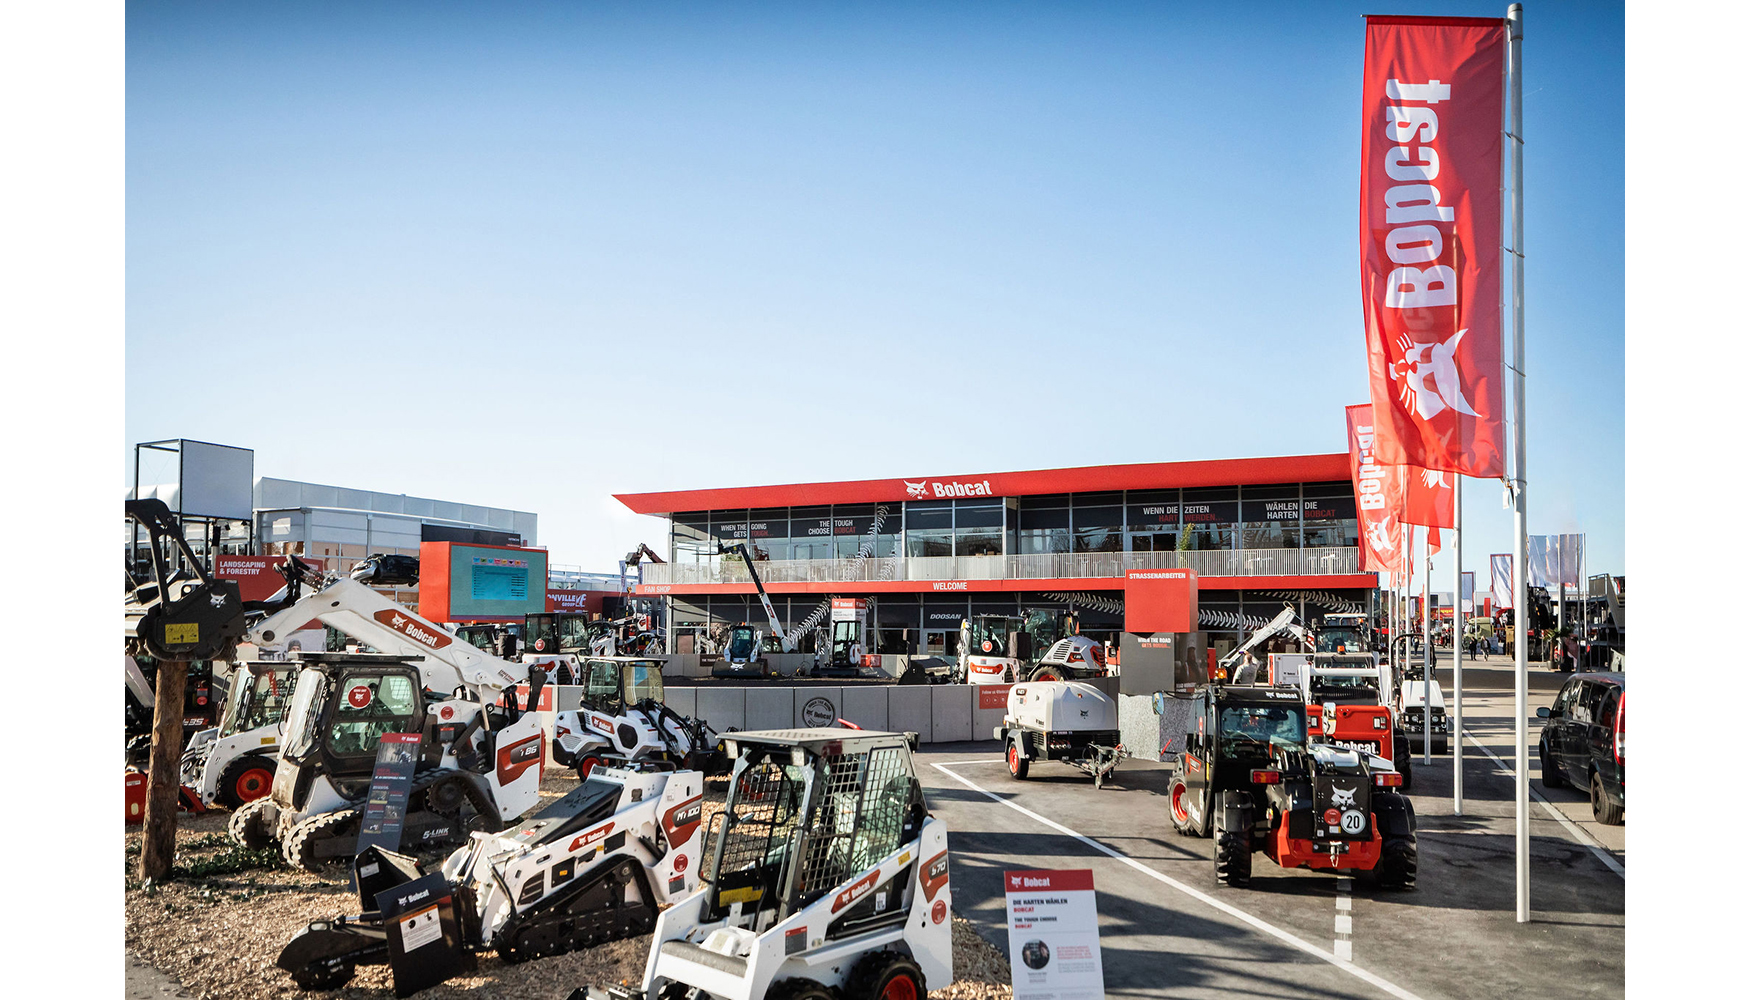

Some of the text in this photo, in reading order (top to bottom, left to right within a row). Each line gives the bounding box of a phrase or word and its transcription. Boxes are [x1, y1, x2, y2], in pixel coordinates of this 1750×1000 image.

[932, 480, 992, 498] Bobcat
[1166, 506, 1178, 514] DIE
[1184, 505, 1210, 514] ZEITEN
[1265, 502, 1318, 511] WÄHLEN DIE
[1266, 509, 1335, 519] HARTEN BOBCAT
[933, 582, 968, 590] WELCOME
[405, 623, 438, 646] Bobcat
[1346, 815, 1360, 828] 20
[422, 827, 449, 839] 5-LINK
[588, 829, 605, 842] Bobcat
[1024, 877, 1050, 887] Bobcat
[408, 889, 430, 902] Bobcat
[851, 880, 870, 899] Bobcat
